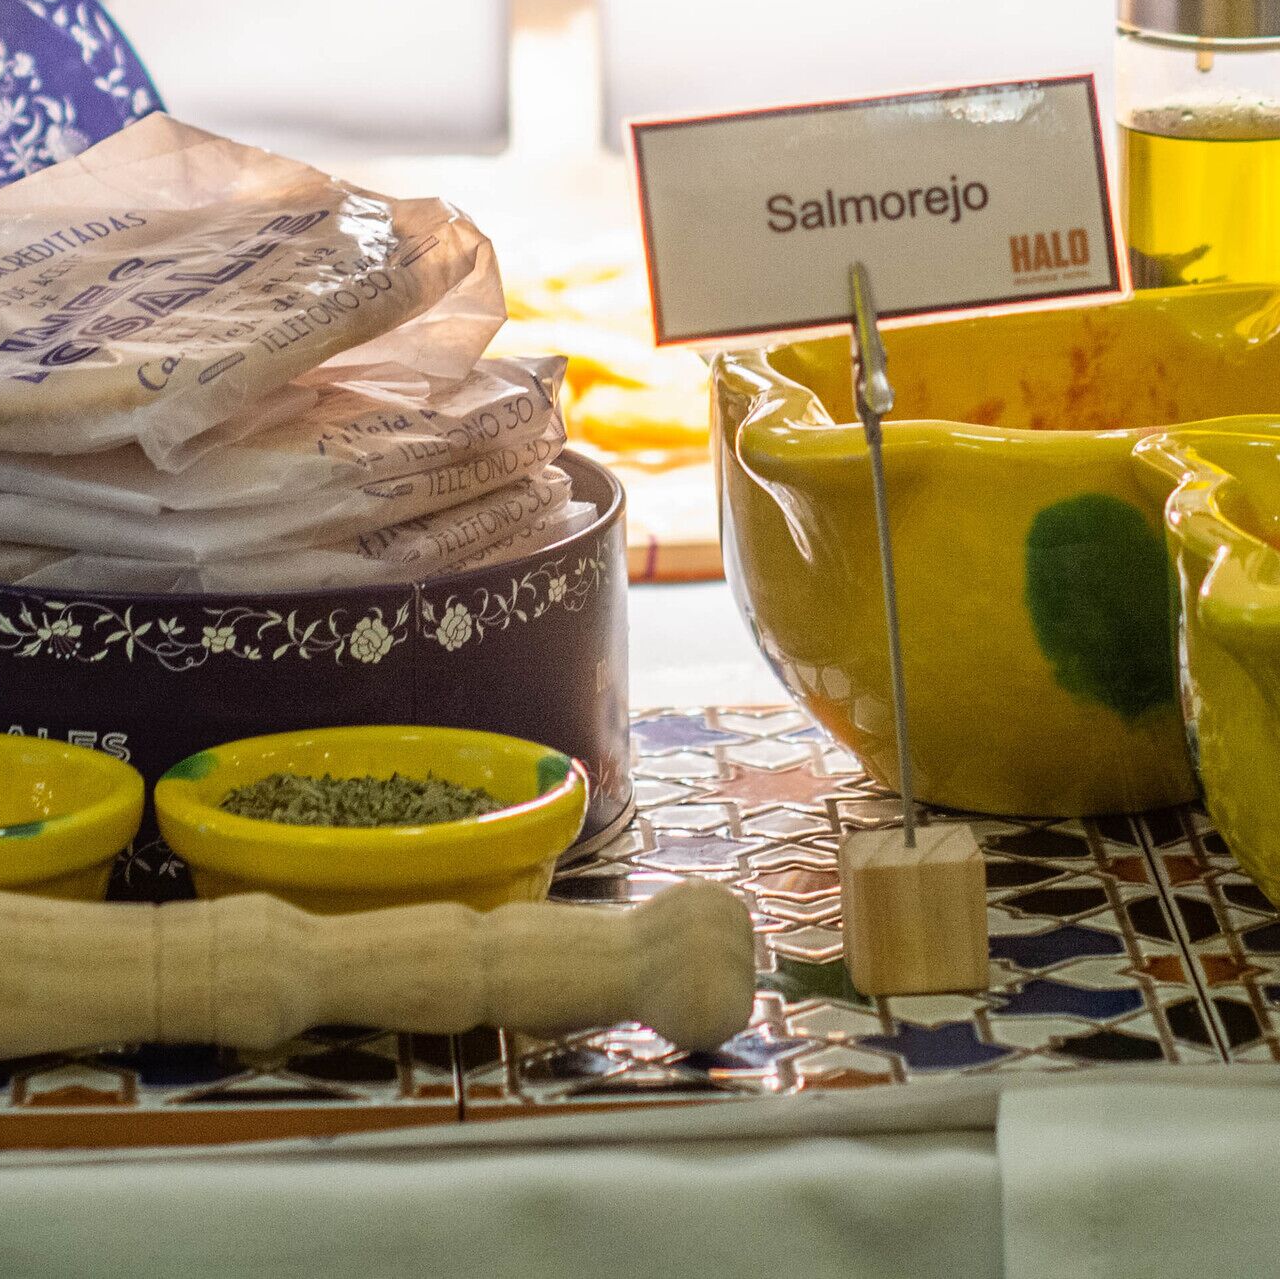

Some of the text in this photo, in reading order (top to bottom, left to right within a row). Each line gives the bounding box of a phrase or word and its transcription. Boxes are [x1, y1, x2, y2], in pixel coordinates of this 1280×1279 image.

[766, 174, 989, 233] Salmorejo
[1008, 227, 1090, 274] HALO
[354, 270, 392, 300] 30
[503, 396, 534, 430] 30
[523, 439, 551, 468] 30
